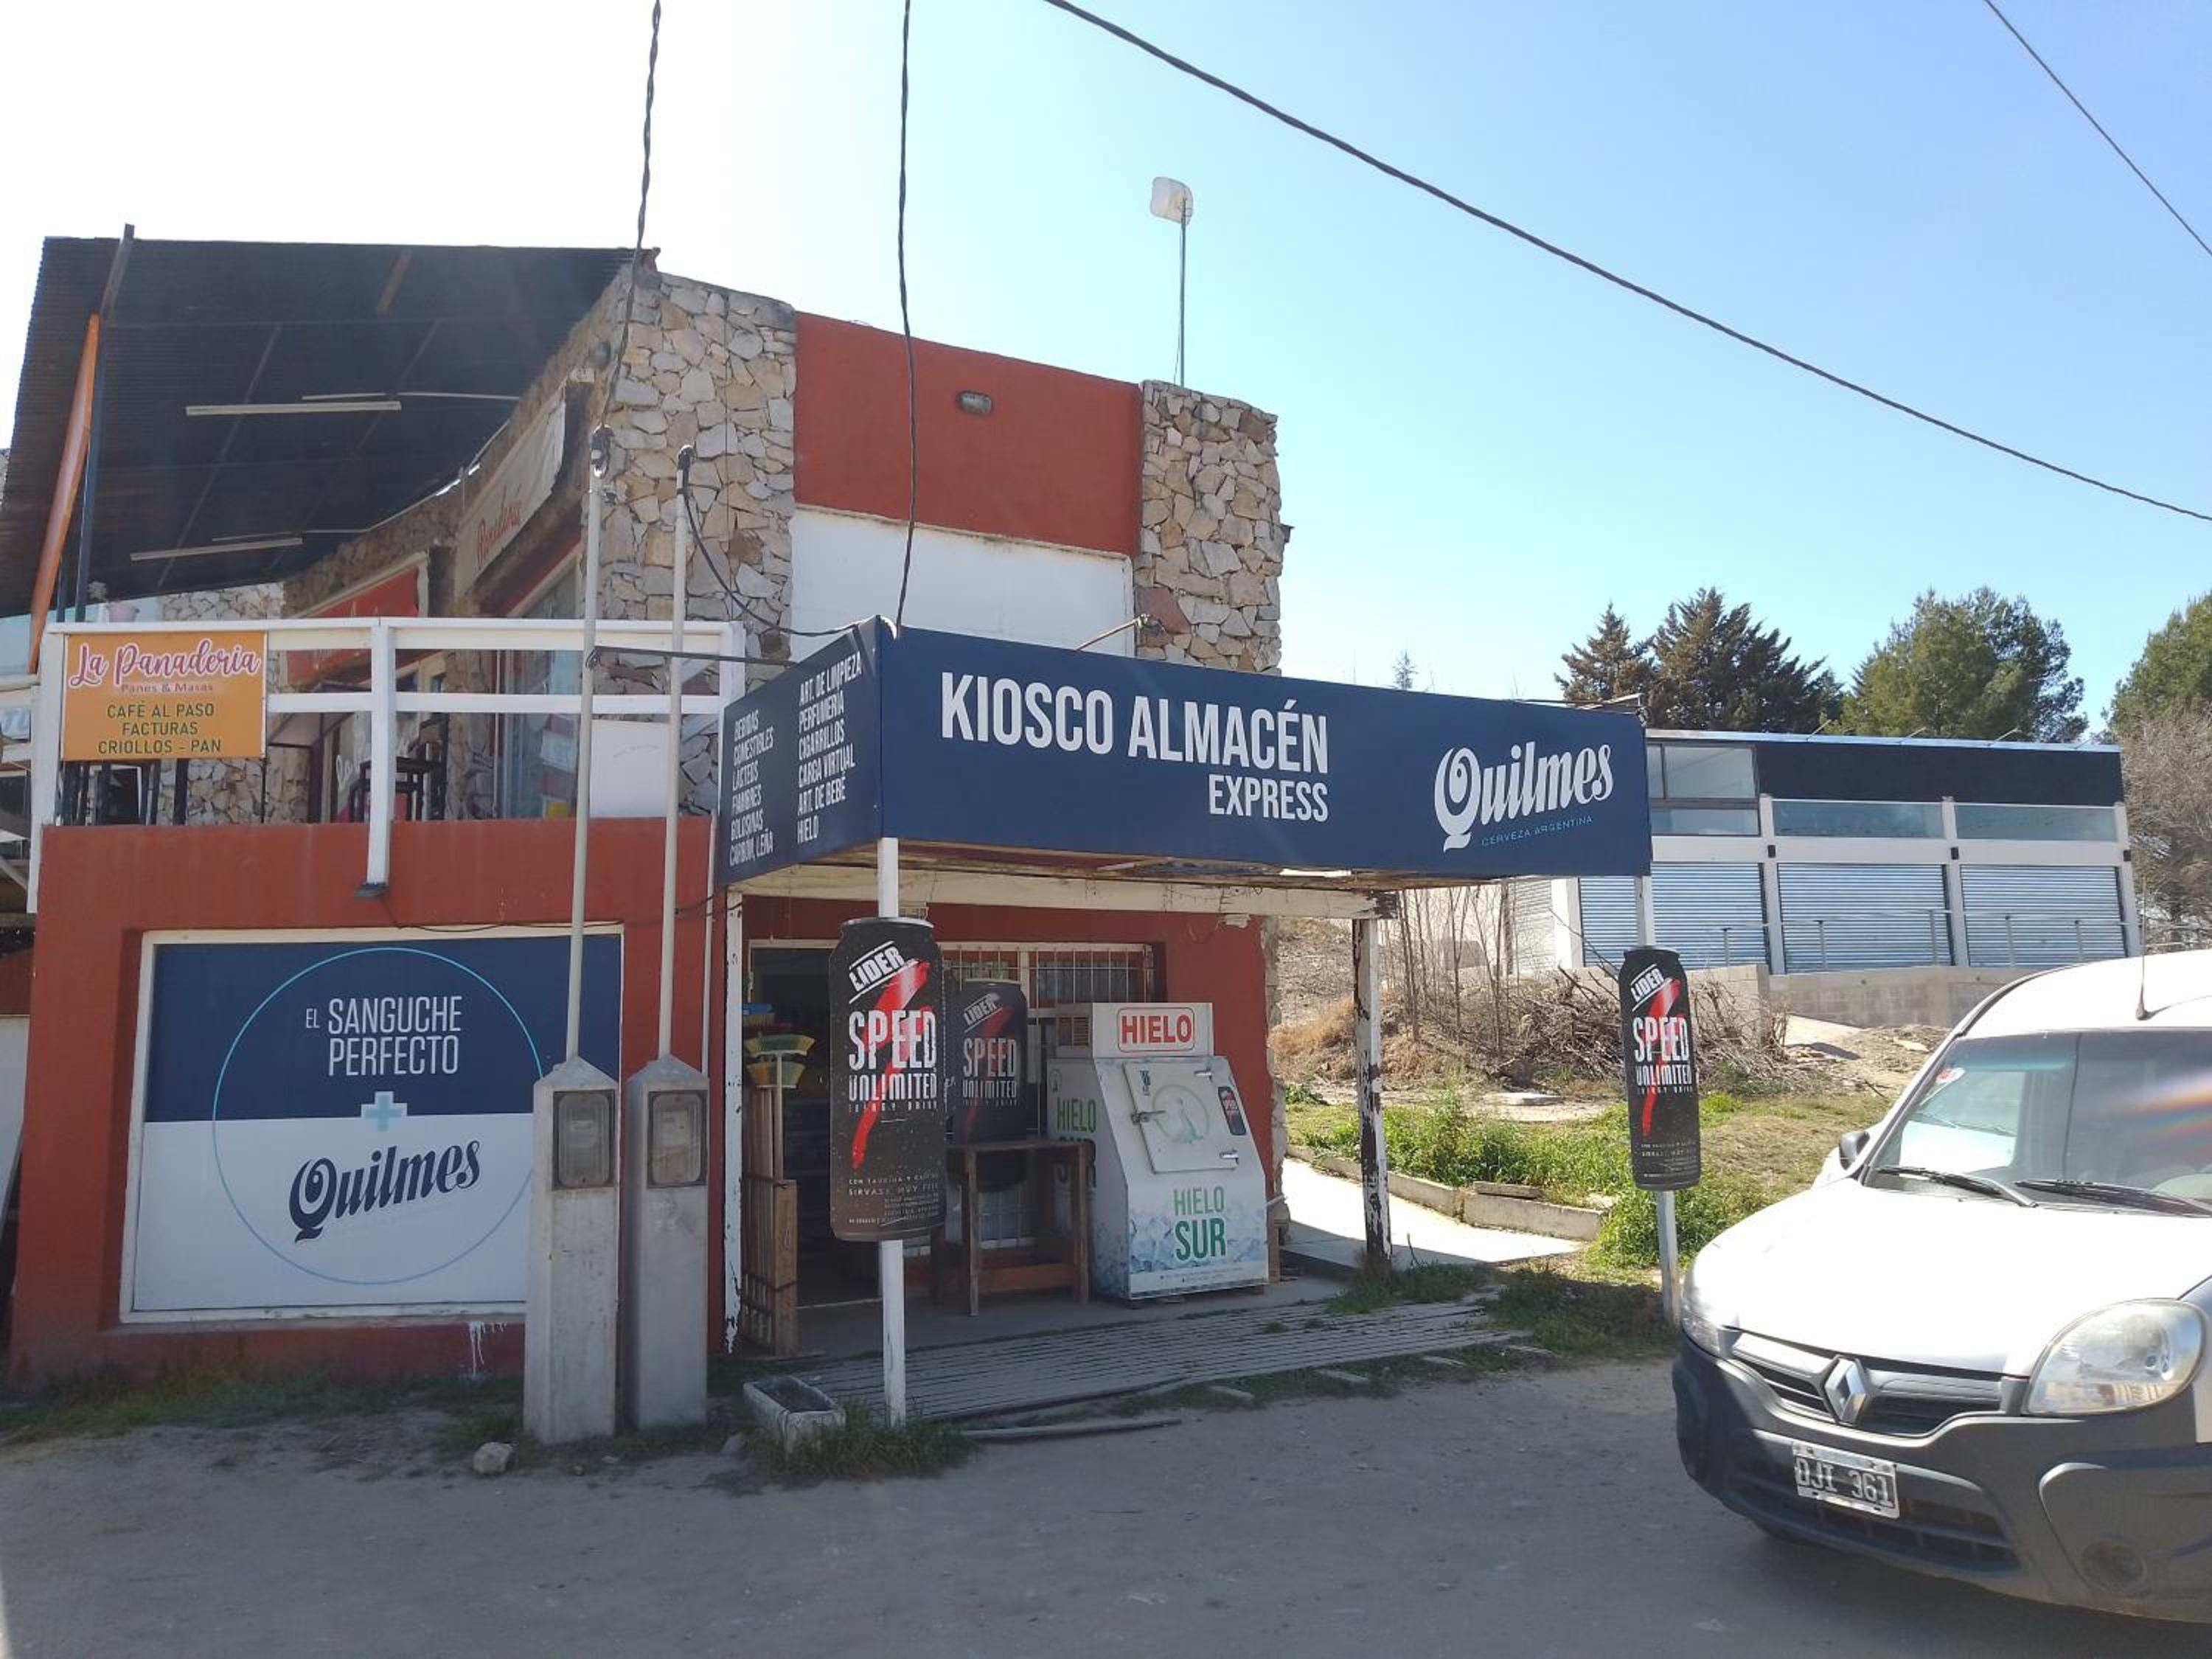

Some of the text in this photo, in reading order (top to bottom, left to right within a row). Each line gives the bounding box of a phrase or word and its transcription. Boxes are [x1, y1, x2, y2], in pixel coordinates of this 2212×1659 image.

[70, 641, 109, 689] La
[815, 674, 825, 693] DE
[827, 650, 862, 692] LIMPIEZA
[107, 700, 215, 719] CAFÉ AL PASO
[122, 721, 199, 736] FACTURAS
[942, 672, 1328, 774] KIOSCO ALMACÉN
[98, 739, 173, 755] CRIOLLOS
[191, 738, 221, 753] PAN
[734, 726, 774, 767] COMESTIBLES
[799, 718, 846, 761] CIGARRILLOS
[799, 742, 855, 788] CARGA VIRTUAL
[731, 785, 762, 816] FIAMBRES
[814, 785, 825, 810] DE
[1208, 773, 1329, 822] EXPRESS
[1434, 741, 1614, 853] Quilmes
[731, 809, 764, 842] GOLOSINAS
[796, 814, 819, 844] HIELO
[1481, 815, 1593, 846] CERVEZA ARGENTINA
[849, 945, 906, 992] LIDER
[1630, 967, 1665, 1003] LIDER
[305, 995, 463, 1034] EL SANGUCHE
[963, 998, 997, 1026] LIDER
[1121, 1013, 1193, 1044] HIELO
[328, 1034, 460, 1077] PERFECTO
[849, 1009, 937, 1071] SPEED
[963, 1037, 1018, 1077] SPEED
[1632, 1016, 1690, 1062] SPEED
[1057, 1096, 1097, 1133] HIELO
[288, 1140, 481, 1243] Quilmes
[1173, 1186, 1225, 1217] HIELO
[1174, 1217, 1227, 1262] SUR
[1848, 1470, 1895, 1509] 361
